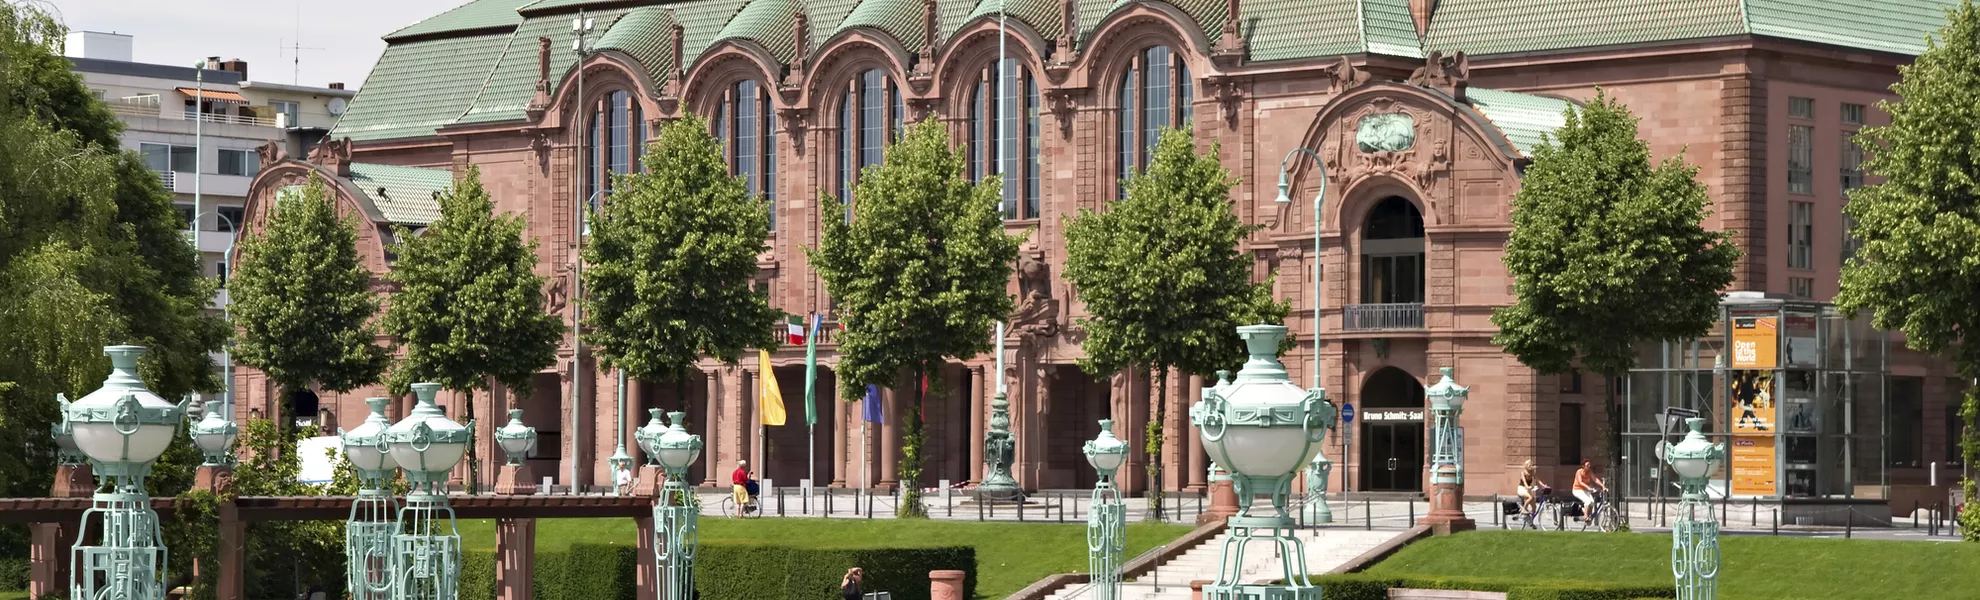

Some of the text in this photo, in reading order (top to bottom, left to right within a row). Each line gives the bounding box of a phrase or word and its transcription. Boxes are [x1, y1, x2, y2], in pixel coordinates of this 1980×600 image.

[1735, 340, 1756, 350] Open
[1744, 347, 1756, 355] the
[1736, 353, 1756, 361] World
[1363, 411, 1383, 420] Bruno
[1384, 411, 1424, 420] Schmitz-Saal
